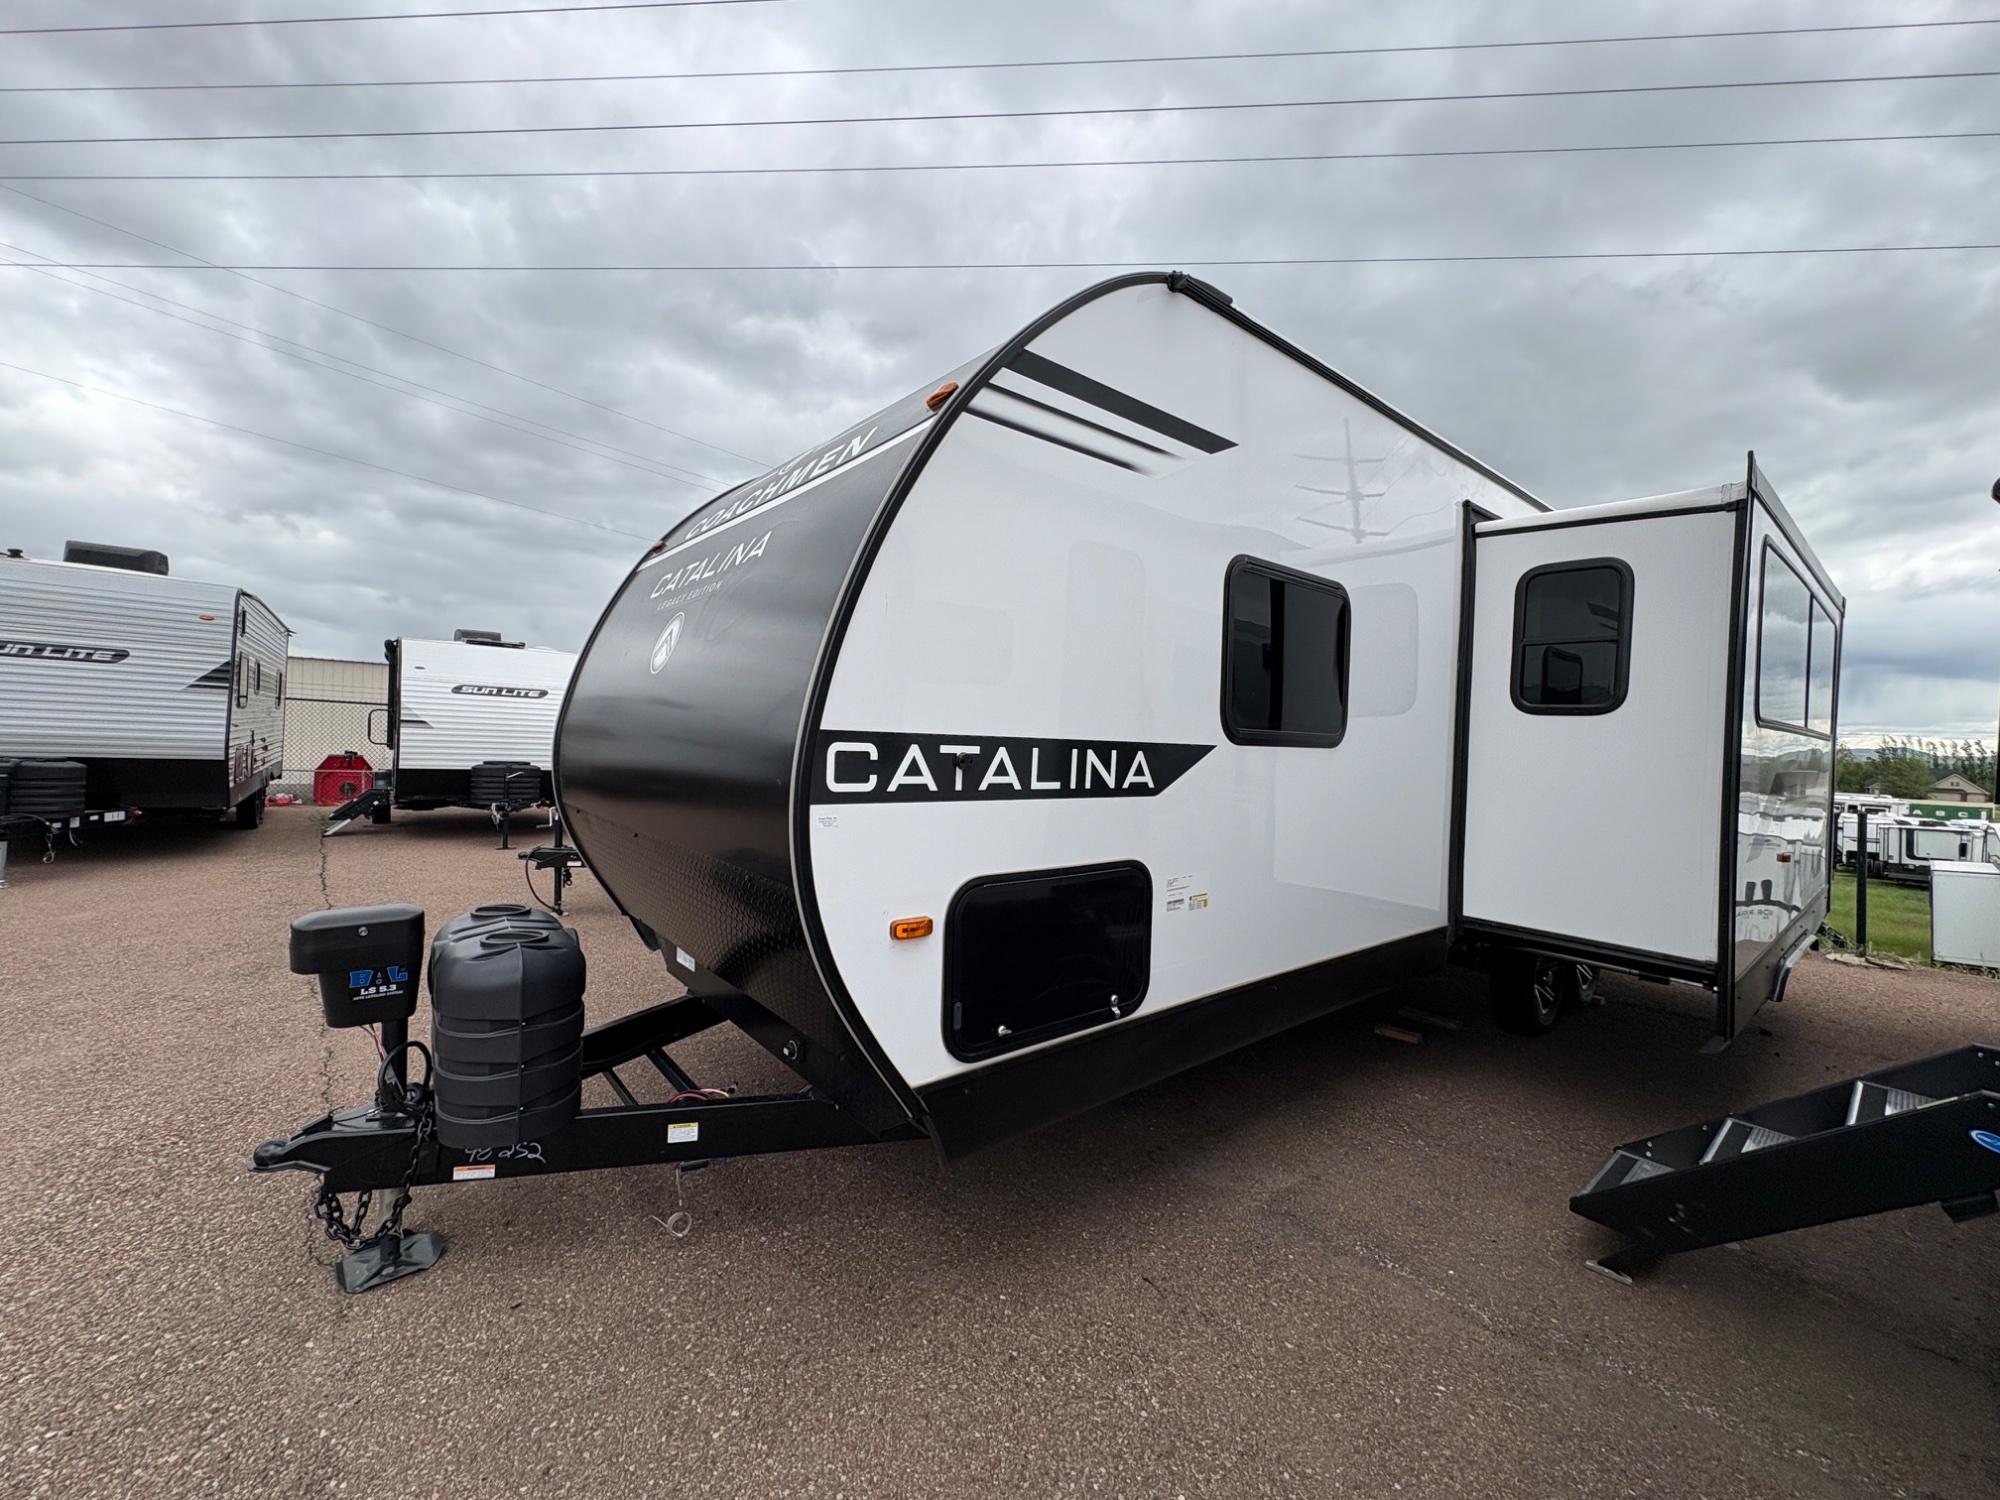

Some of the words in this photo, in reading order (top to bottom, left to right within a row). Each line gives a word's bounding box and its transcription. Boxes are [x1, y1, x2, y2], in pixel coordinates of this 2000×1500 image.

[685, 426, 879, 540] COACHMEN
[650, 530, 772, 599] CATALINA
[656, 595, 687, 611] LEGACY
[686, 579, 724, 602] EDITION
[41, 646, 116, 661] LITE
[460, 685, 498, 695] SUN
[501, 688, 541, 698] LITE
[826, 741, 1155, 793] CATALINA
[349, 966, 408, 988] BAL
[360, 987, 377, 995] LS
